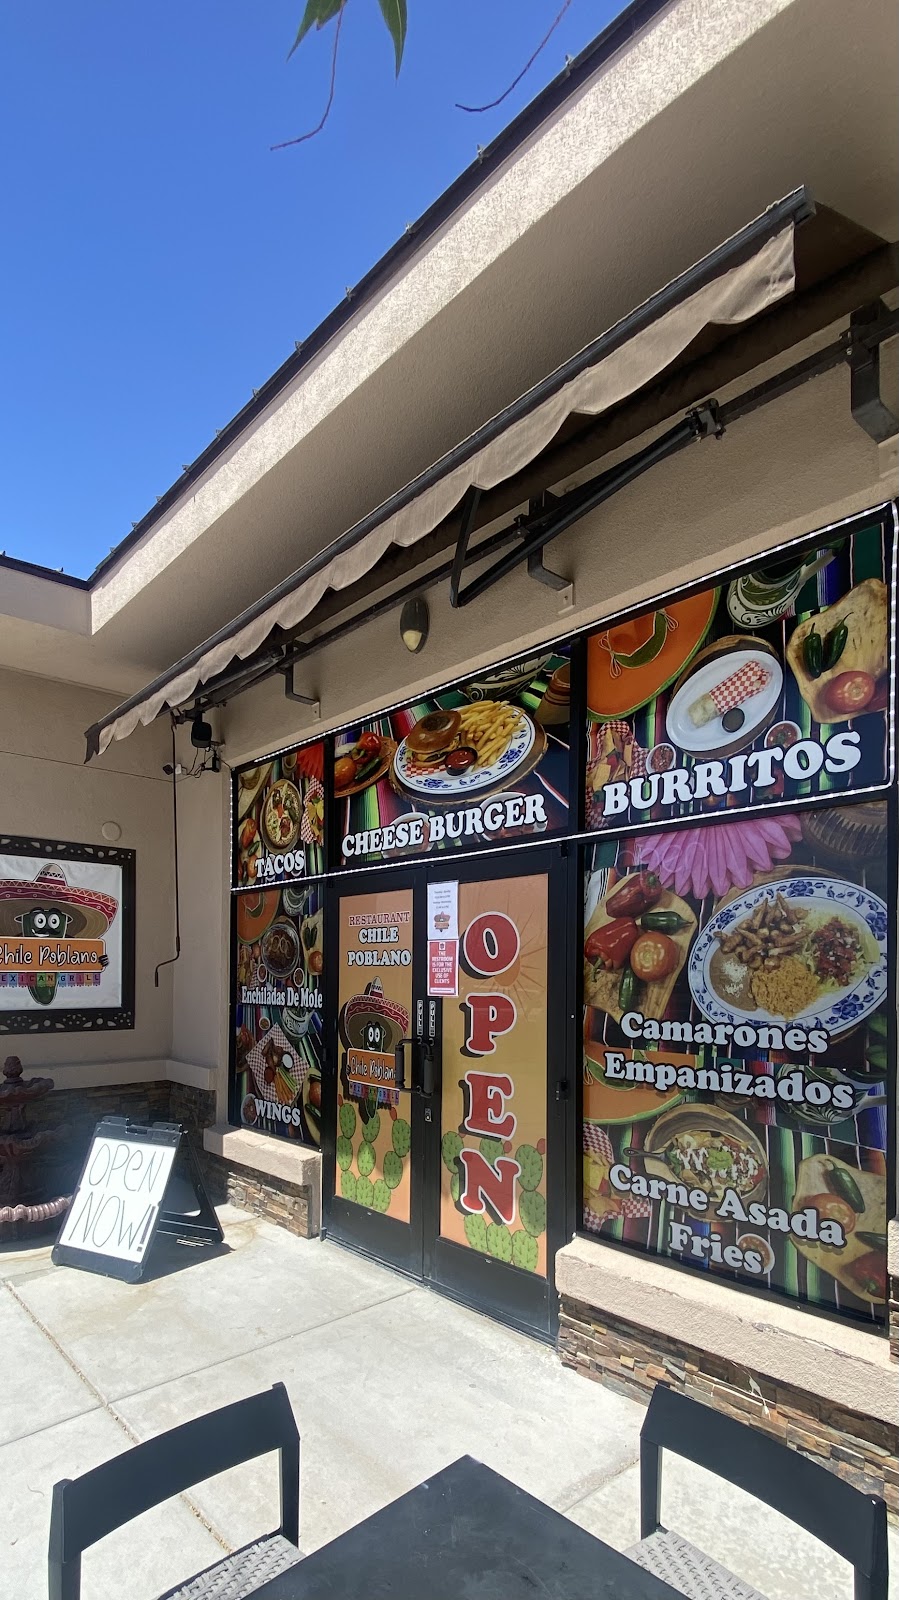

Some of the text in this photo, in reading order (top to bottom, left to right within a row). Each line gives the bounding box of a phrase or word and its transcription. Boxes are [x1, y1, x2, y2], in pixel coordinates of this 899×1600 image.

[602, 731, 862, 816] BURRITOS
[341, 794, 547, 857] CHEESE BURGER
[254, 849, 305, 878] TACOS
[349, 911, 410, 926] RESTAURANT
[358, 926, 399, 944] CHILE
[39, 944, 98, 966] Poblano
[347, 949, 411, 966] POBLANO
[241, 985, 323, 1009] Enchiladas De Mole
[621, 1012, 829, 1053] Camarones
[351, 1055, 396, 1081] Chile Poblan
[460, 910, 522, 1225] OPEN
[604, 1052, 854, 1108] Empanizados
[254, 1098, 301, 1127] WINGS
[609, 1164, 845, 1246] Carne Asada
[668, 1221, 764, 1275] Fries
